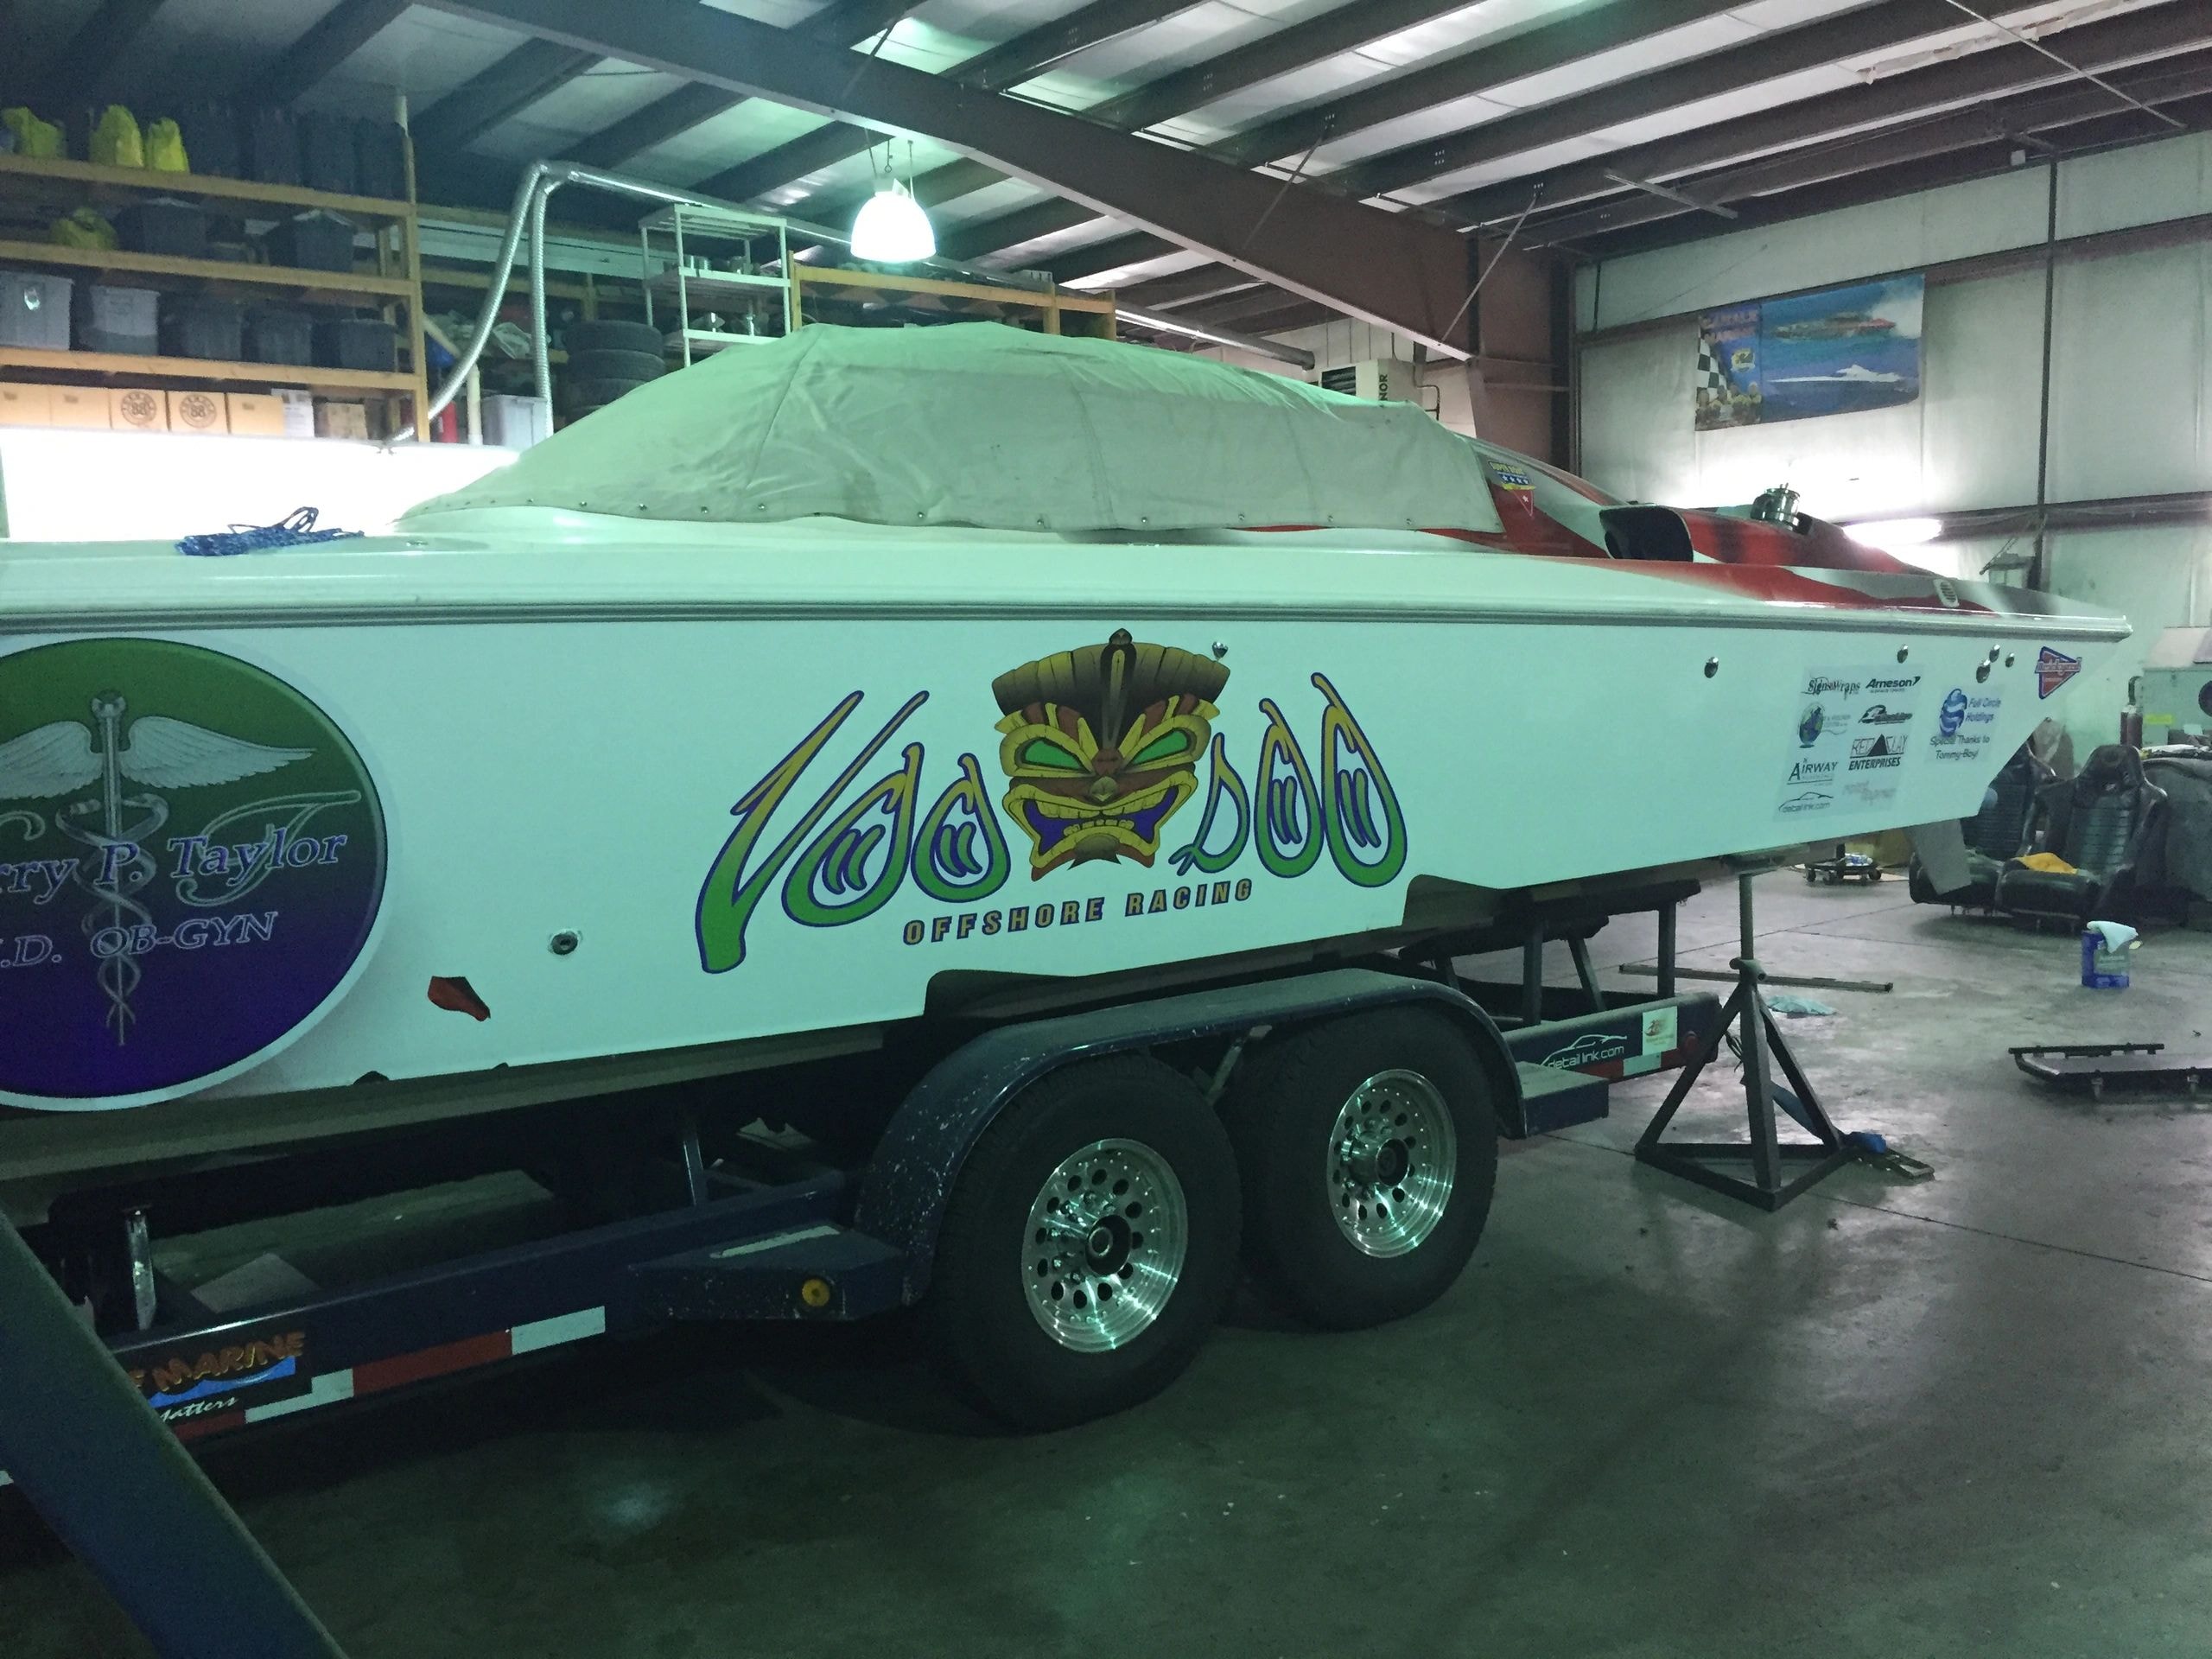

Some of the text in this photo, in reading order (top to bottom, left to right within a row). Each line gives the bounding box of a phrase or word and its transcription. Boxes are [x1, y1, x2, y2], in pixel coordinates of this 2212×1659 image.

[1866, 677, 1913, 690] Arneson
[1848, 756, 1902, 772] ENTERPRISES
[1929, 734, 1991, 747] Special Thanks to
[94, 842, 144, 885] P.
[168, 824, 348, 887] Taylor
[902, 878, 1254, 945] OFFSHORE RACING
[89, 912, 279, 959] OB-GYN
[151, 1332, 305, 1392] MARINE
